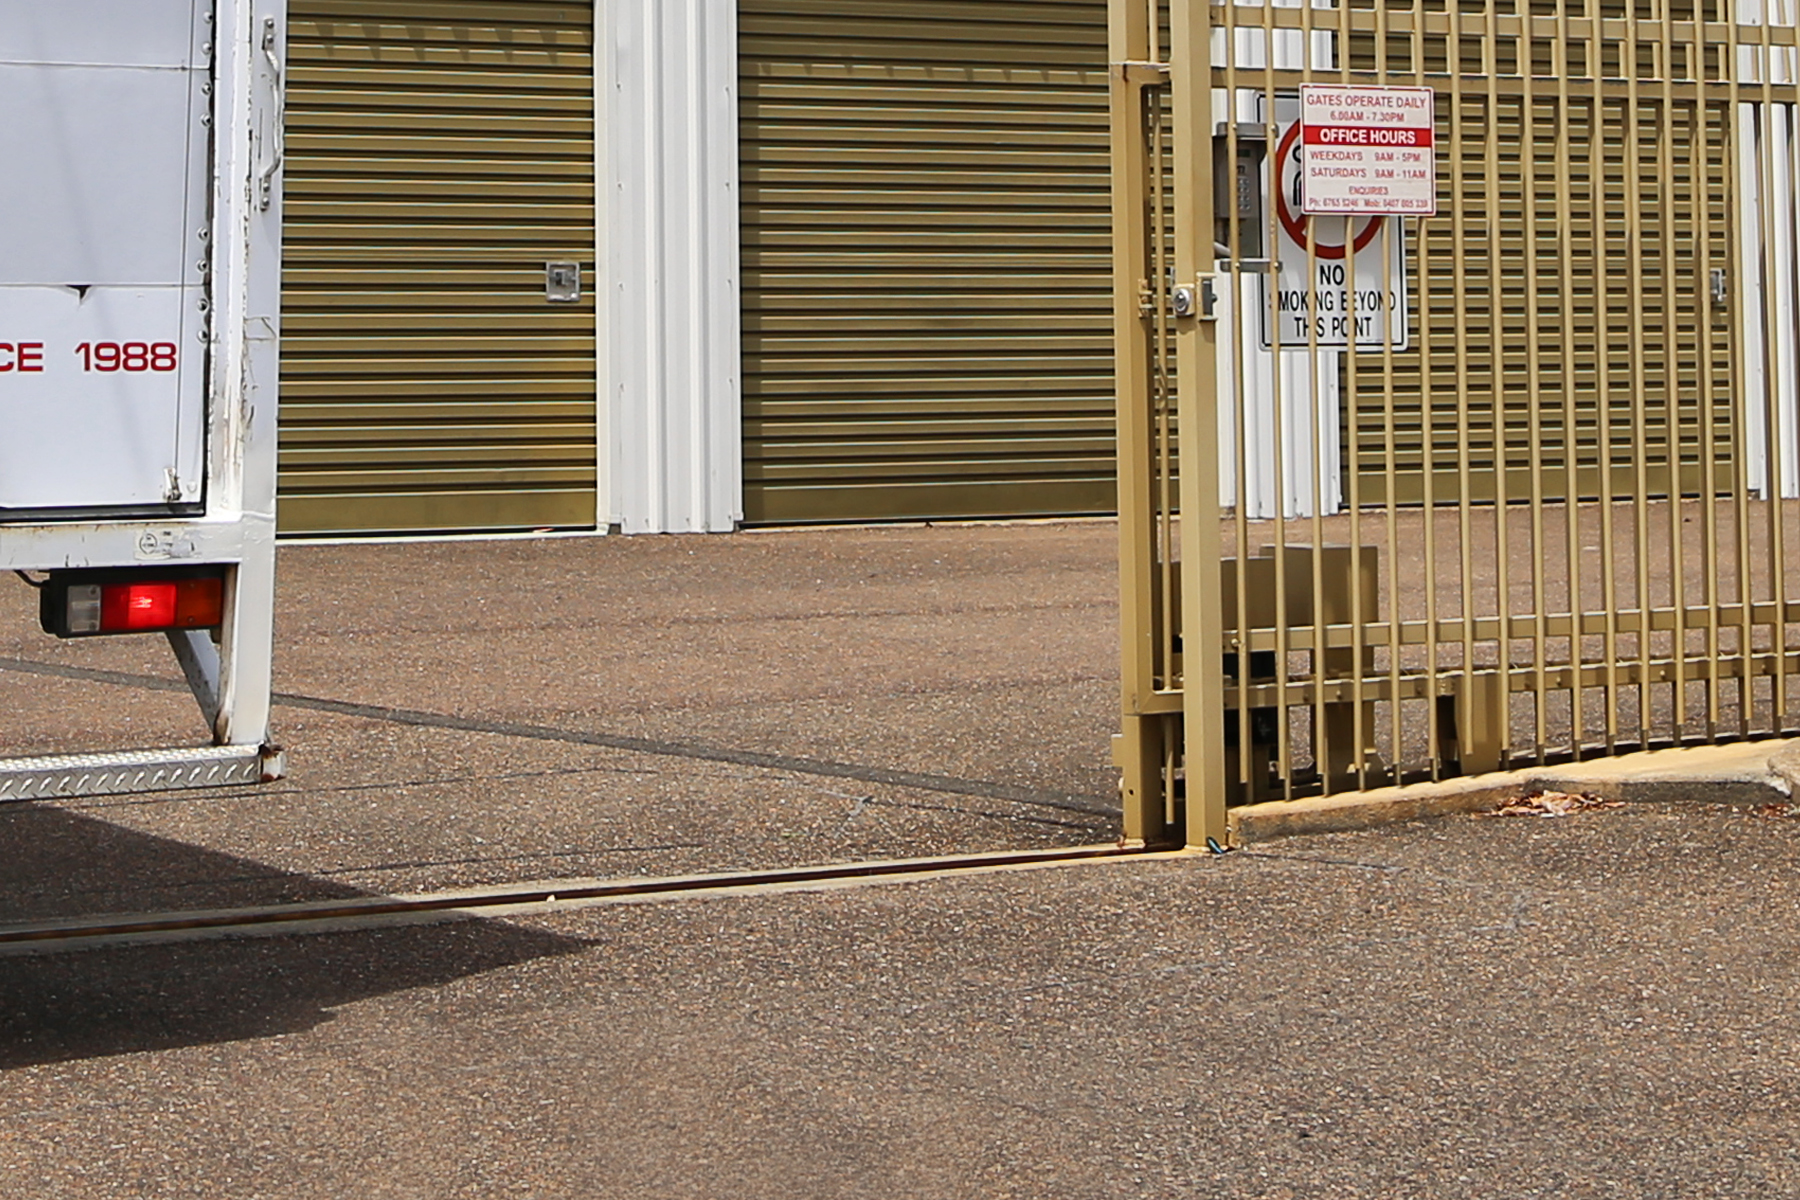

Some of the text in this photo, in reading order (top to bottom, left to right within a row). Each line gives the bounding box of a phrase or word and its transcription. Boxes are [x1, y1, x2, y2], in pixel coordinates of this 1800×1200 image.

[1307, 94, 1426, 109] GATES OPERATE DAILY
[1320, 128, 1416, 144] OFFICE HOURS
[1310, 151, 1363, 161] WEEKDAYS
[1374, 152, 1394, 162] 9AM
[1402, 152, 1421, 162] 5PM
[1311, 167, 1367, 178] SATURDAYS
[1374, 168, 1394, 178] 9AM
[1402, 169, 1426, 179] 11AM
[1349, 186, 1389, 196] ENQUIRIES
[1320, 264, 1345, 286] NO
[1269, 290, 1334, 311] MOKNG
[1294, 316, 1372, 337] THS PONT
[75, 342, 177, 373] 1988
